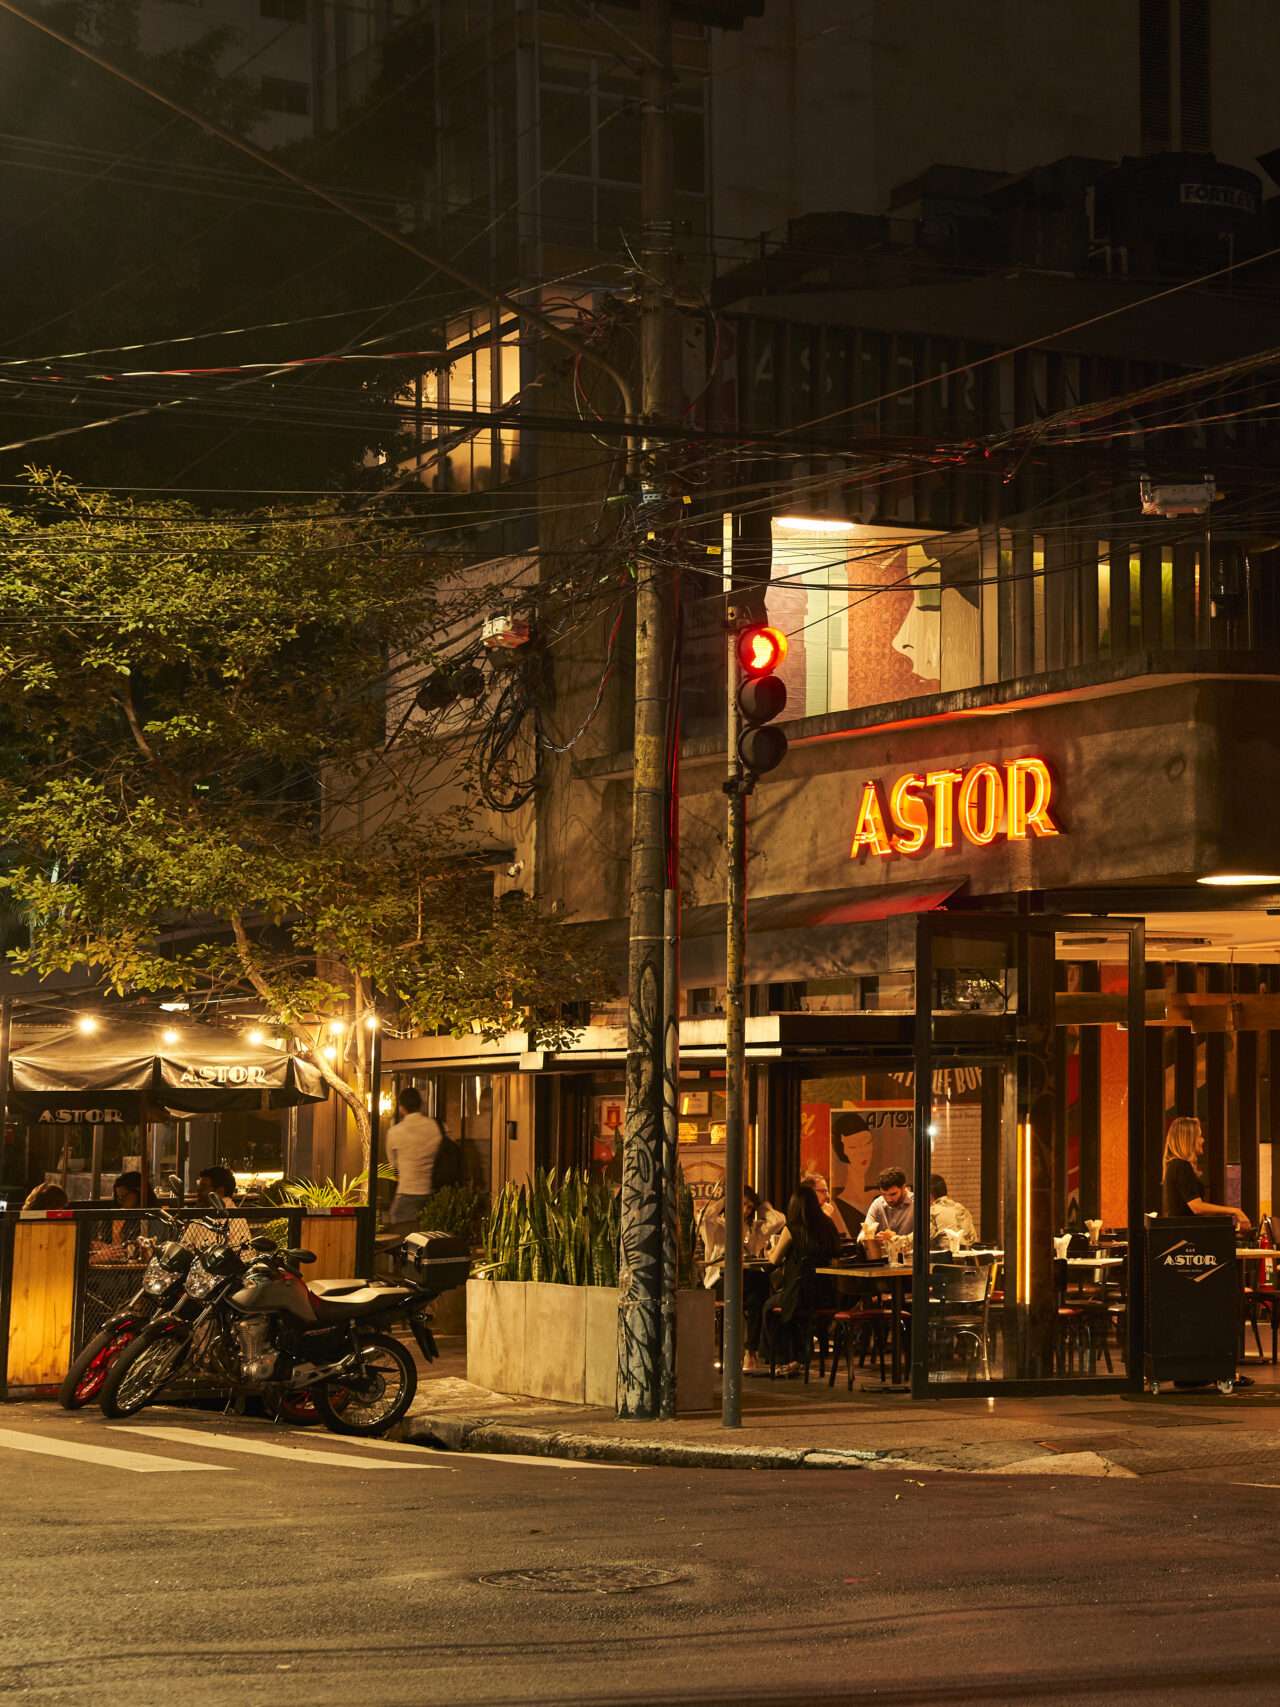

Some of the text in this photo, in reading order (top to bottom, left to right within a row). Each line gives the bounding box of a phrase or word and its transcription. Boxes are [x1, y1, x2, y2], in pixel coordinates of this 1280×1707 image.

[850, 757, 1060, 859] ASTOR
[180, 1065, 268, 1084] ASTOR
[38, 1108, 124, 1124] ASTOR
[1164, 1253, 1218, 1267] ASTOR
